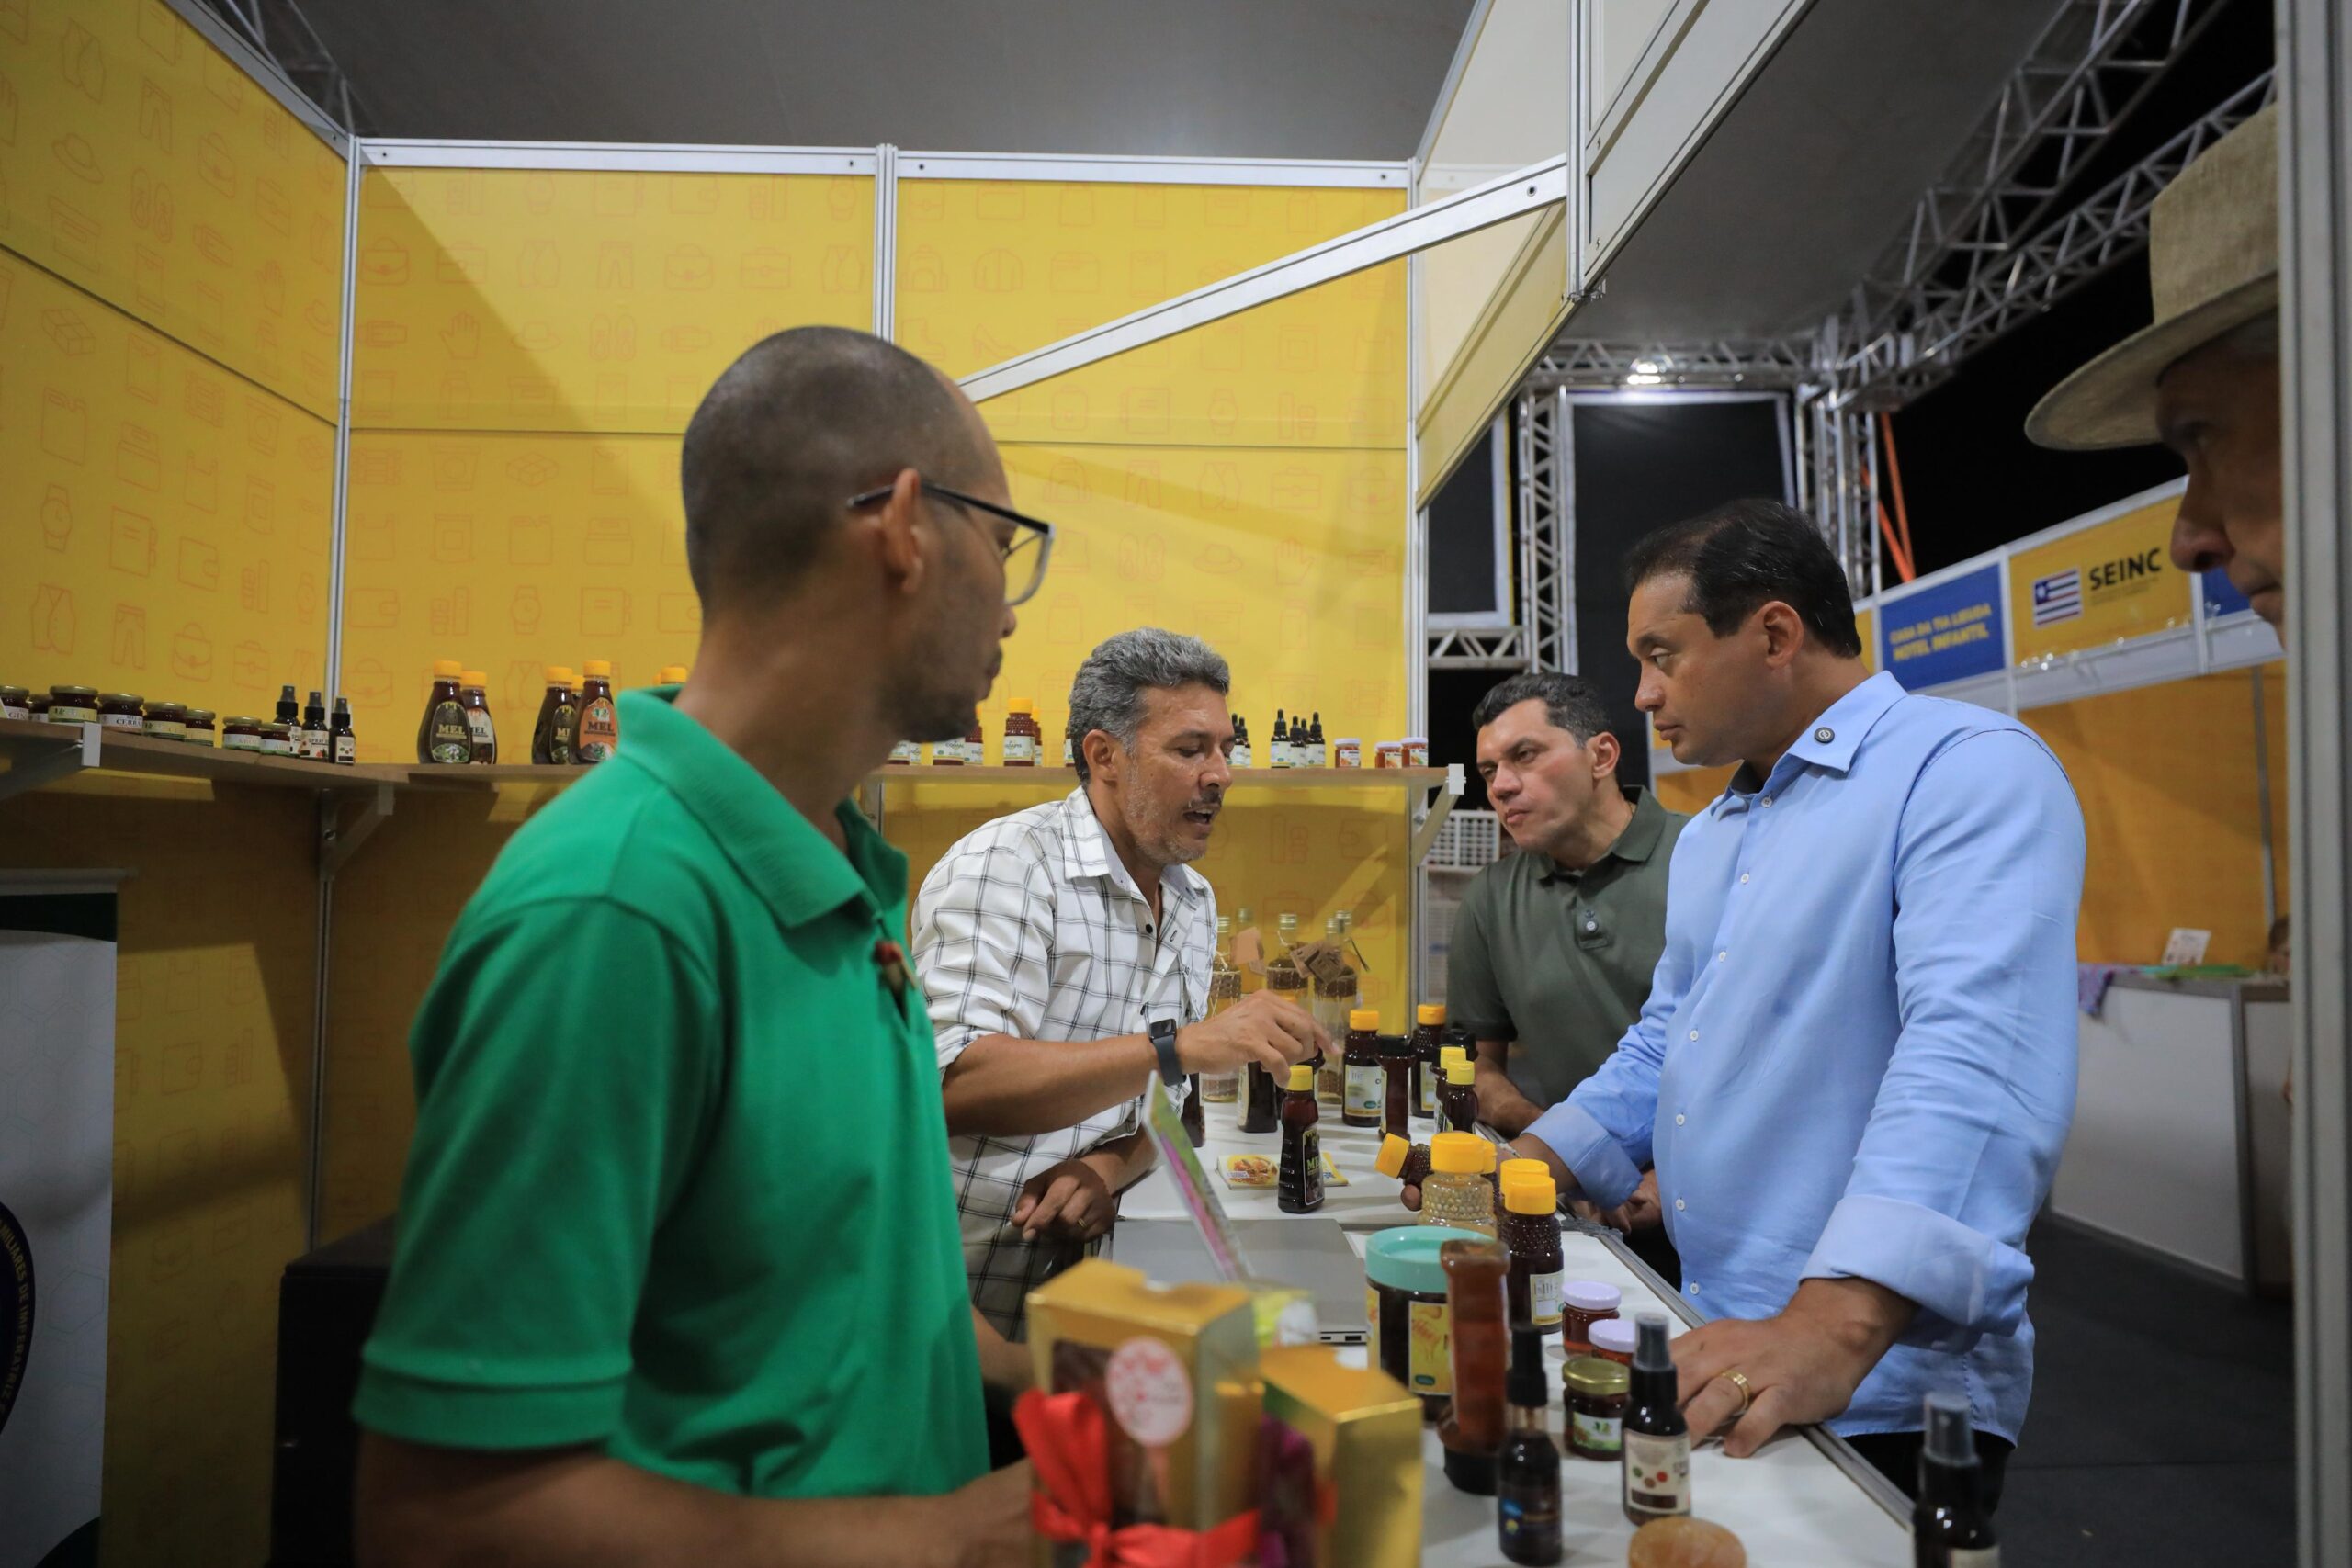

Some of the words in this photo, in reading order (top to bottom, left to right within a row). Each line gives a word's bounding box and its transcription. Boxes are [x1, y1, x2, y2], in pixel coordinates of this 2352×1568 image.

[2088, 547, 2161, 591] SEINC
[1894, 639, 1930, 660] HOTEL
[1932, 623, 1989, 651] INFANTIL
[438, 724, 465, 735] MEL
[588, 721, 615, 732] MEL
[0, 1220, 27, 1280] MILIARES
